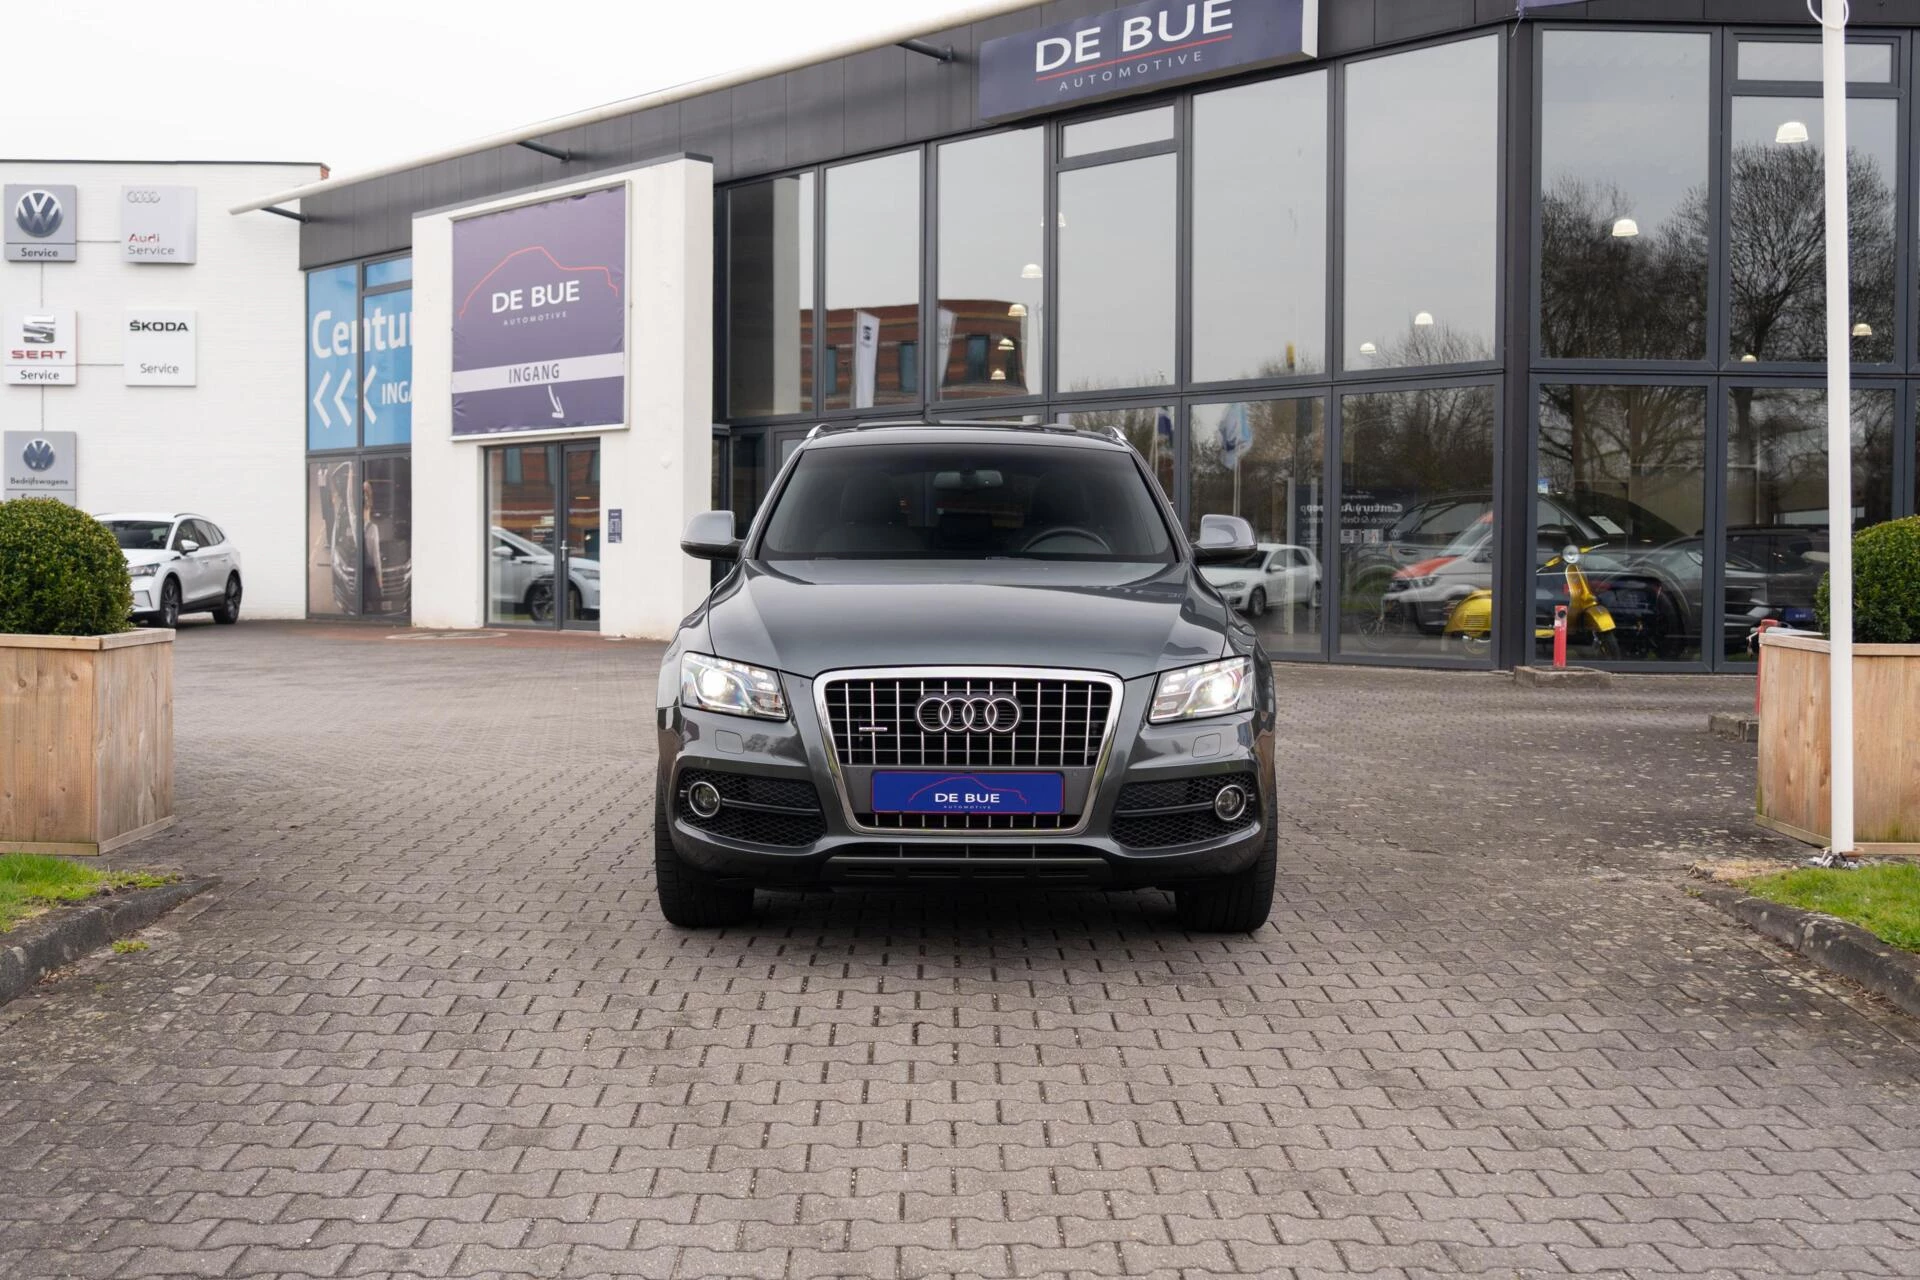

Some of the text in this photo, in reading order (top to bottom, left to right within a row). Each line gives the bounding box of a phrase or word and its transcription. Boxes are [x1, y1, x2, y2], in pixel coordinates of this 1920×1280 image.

[1035, 0, 1233, 73] DE BUE
[1058, 50, 1202, 92] AUTOMOTIVE
[128, 233, 160, 243] Audi
[20, 247, 59, 257] Service
[127, 244, 176, 256] Service
[492, 279, 580, 313] DE BUE
[503, 311, 567, 326] AUTOMOTIVE
[129, 319, 189, 332] ŠKODA
[312, 307, 412, 358] Centu
[11, 350, 67, 360] SEAT
[140, 363, 180, 374] Service
[508, 363, 560, 384] INGANG
[20, 370, 60, 380] Service
[934, 793, 1000, 803] DE BUE
